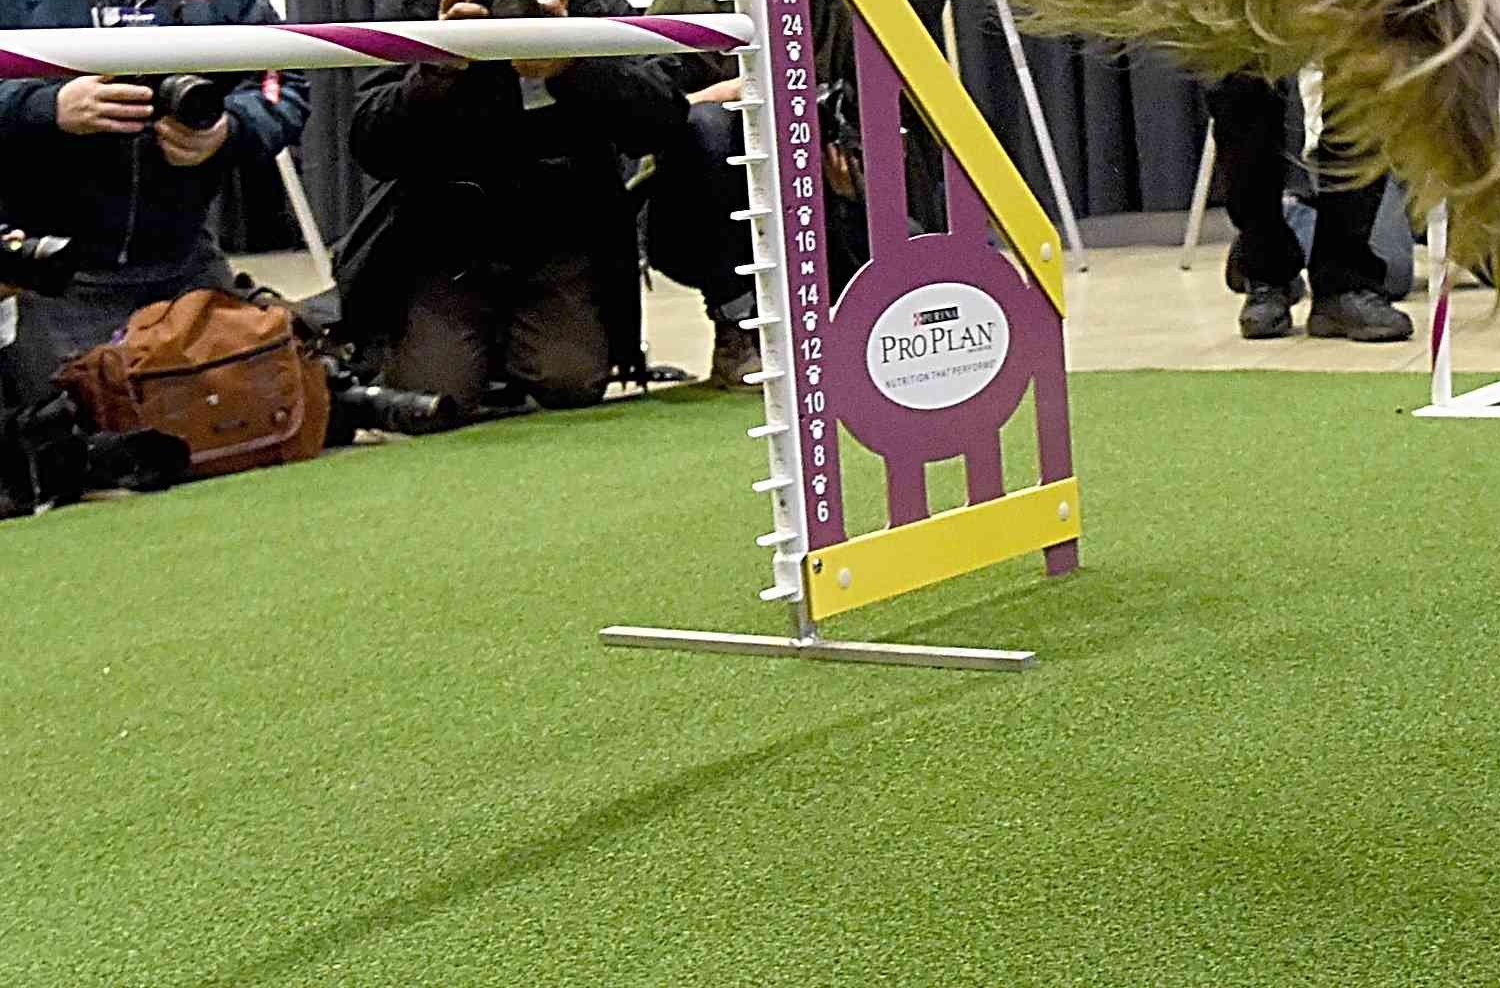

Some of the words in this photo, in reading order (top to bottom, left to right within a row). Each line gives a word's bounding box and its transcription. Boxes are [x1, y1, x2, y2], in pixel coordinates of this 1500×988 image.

[781, 14, 804, 36] 24
[786, 68, 808, 90] 22
[789, 122, 811, 144] 20
[792, 176, 813, 198] 18
[795, 230, 816, 252] 16
[797, 283, 819, 307] 14
[800, 337, 822, 361] 12
[880, 334, 928, 365] PRO
[929, 321, 995, 355] PLAN
[804, 390, 825, 414] 10
[814, 444, 825, 467] 8
[817, 500, 829, 522] 6
